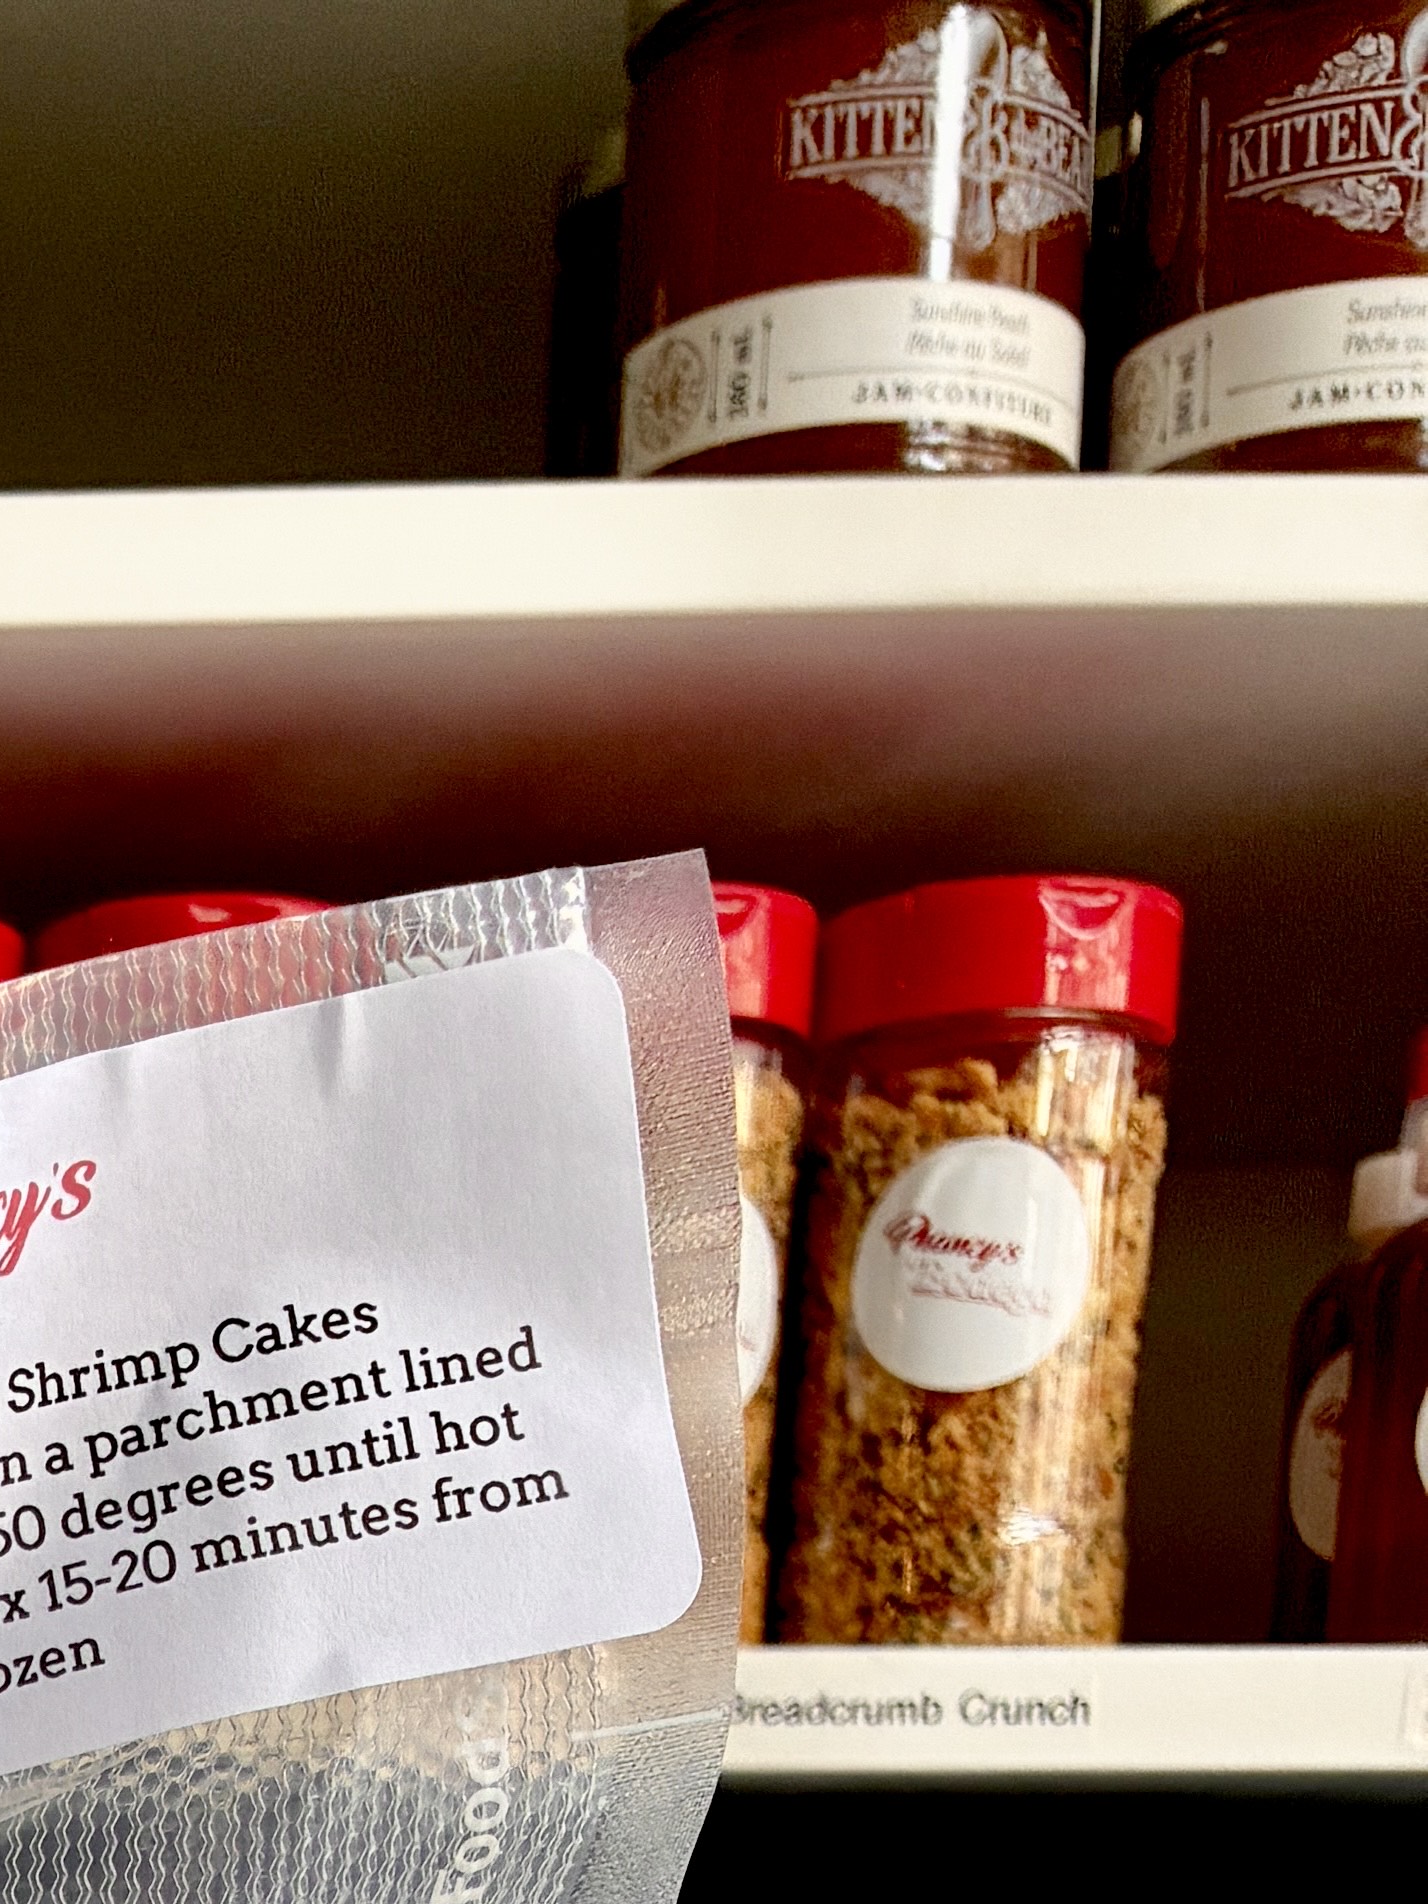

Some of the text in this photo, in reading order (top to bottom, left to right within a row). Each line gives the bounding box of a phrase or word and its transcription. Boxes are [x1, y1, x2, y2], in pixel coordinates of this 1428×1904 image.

[1228, 102, 1394, 187] KITTEN
[7, 1338, 201, 1414] Shrimp
[211, 1300, 380, 1364] Cakes
[44, 1441, 74, 1477] a
[83, 1361, 392, 1477] parchment
[402, 1324, 543, 1394] lined
[60, 1455, 276, 1540] degrees
[286, 1416, 421, 1484] until
[430, 1402, 526, 1456] hot
[37, 1538, 178, 1612] 15-20
[190, 1495, 420, 1574] minutes
[431, 1467, 570, 1525] from
[958, 1687, 1091, 1727] Crunch
